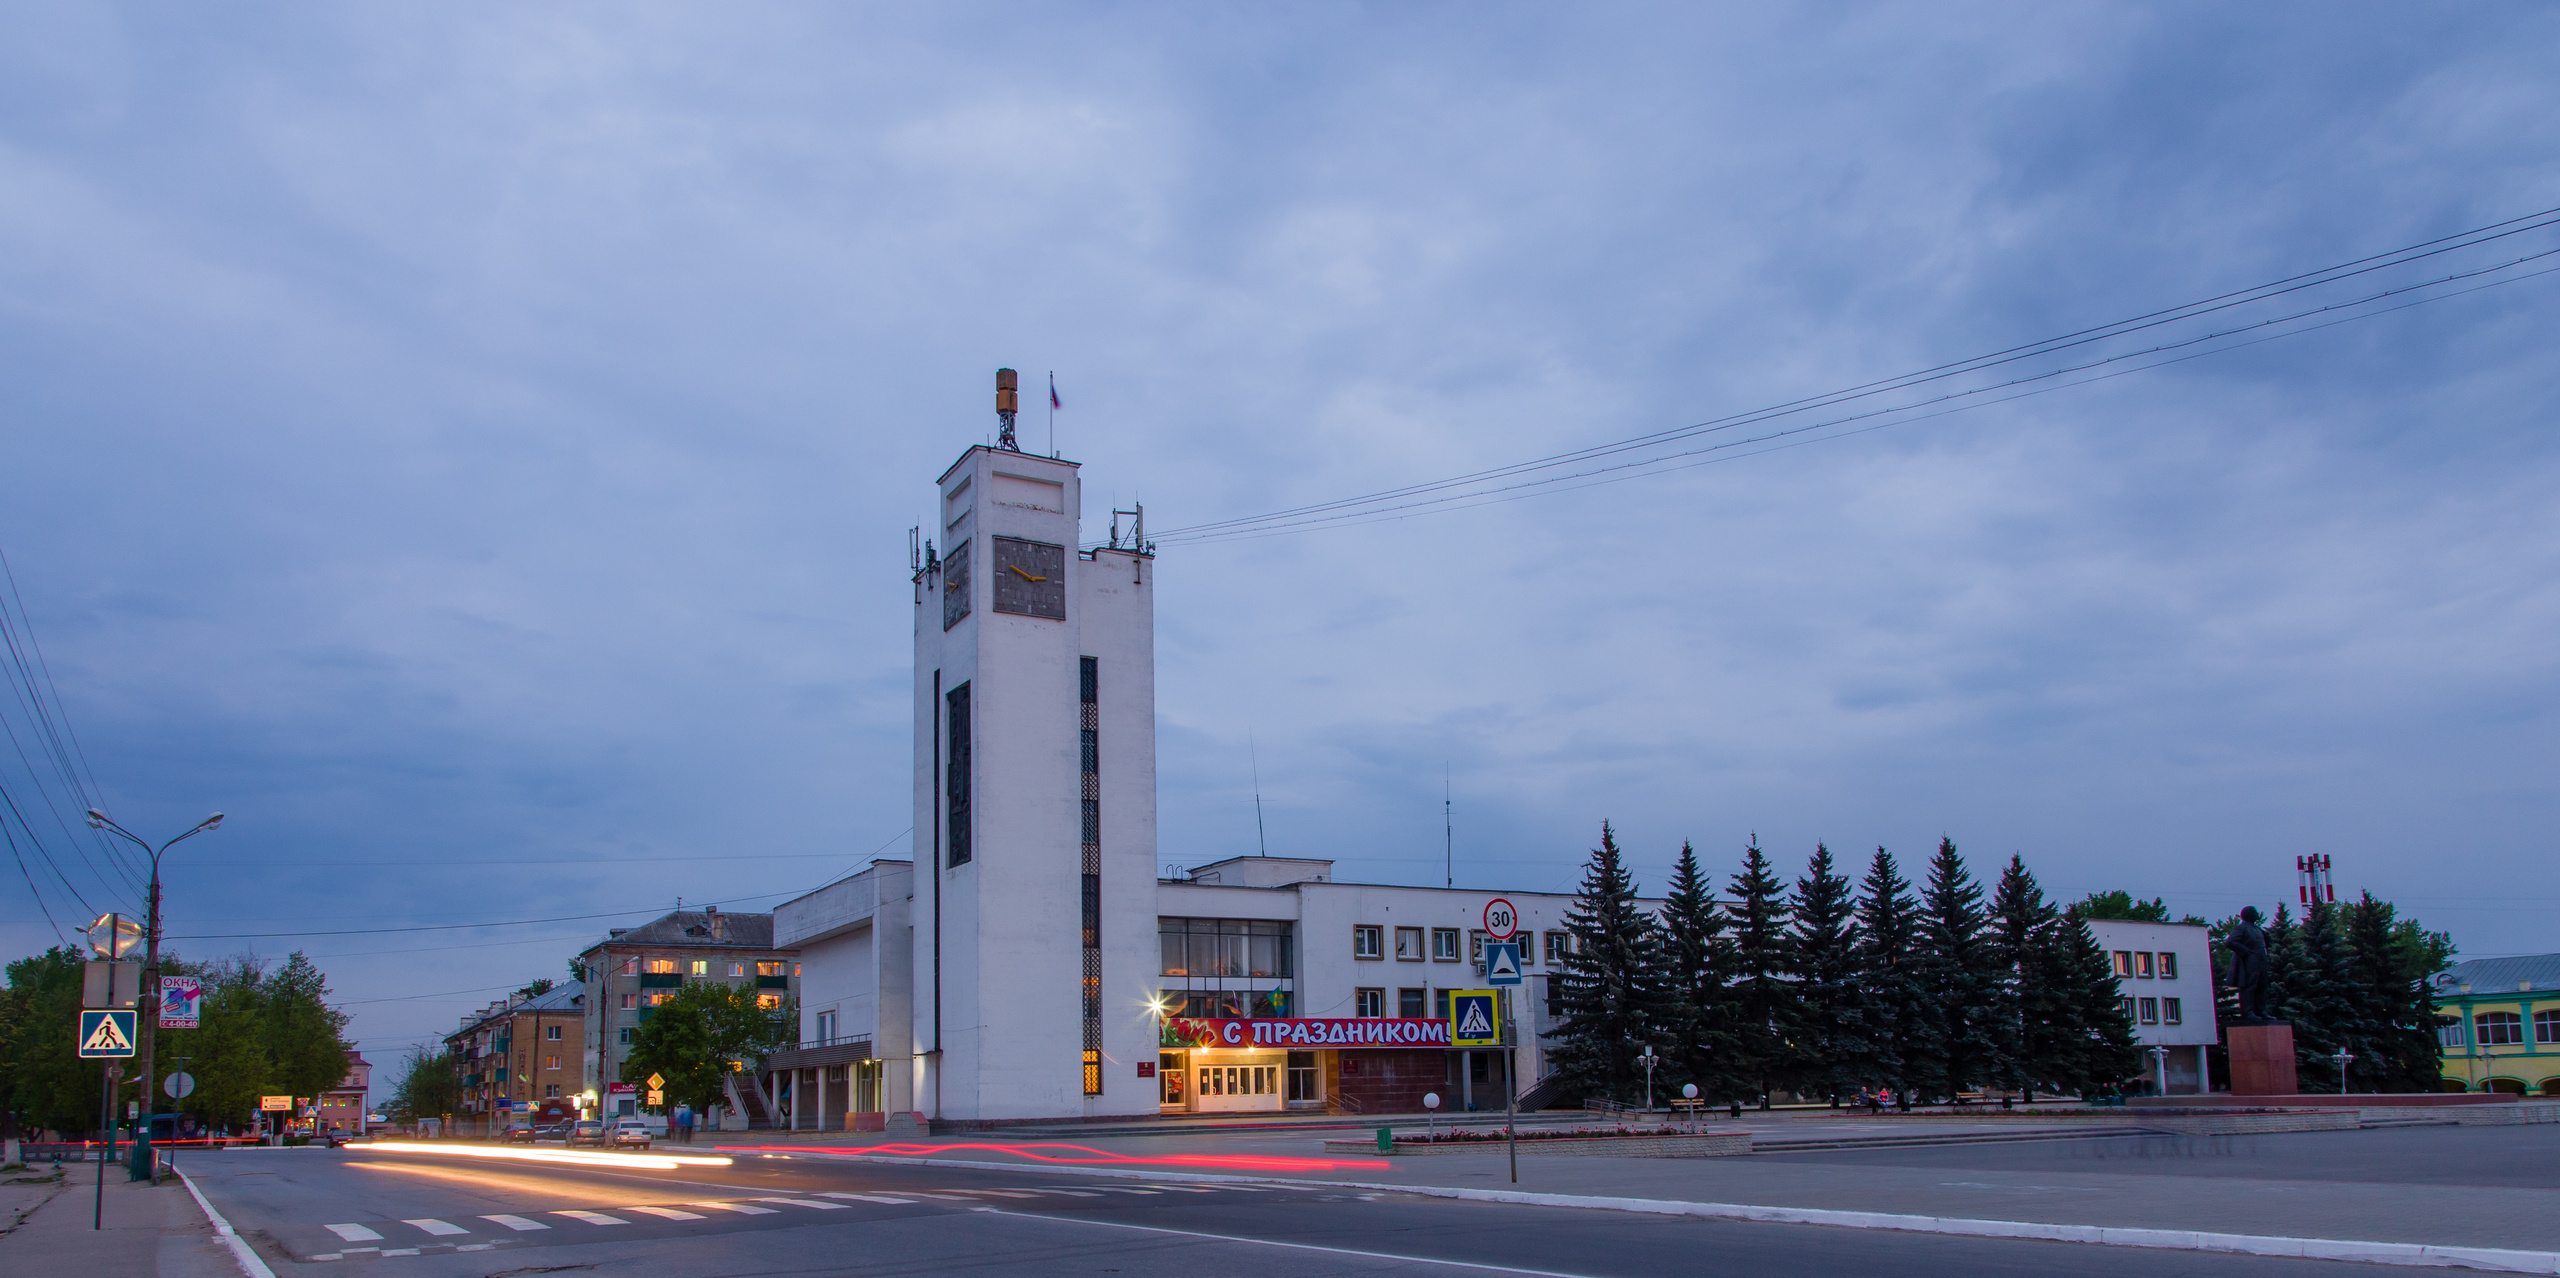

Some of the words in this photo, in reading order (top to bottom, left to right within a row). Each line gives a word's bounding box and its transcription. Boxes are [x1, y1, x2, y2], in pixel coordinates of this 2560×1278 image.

[1491, 911, 1510, 927] 30
[163, 978, 199, 987] ОКНА
[1223, 1021, 1242, 1044] С
[1251, 1021, 1452, 1044] ПРАЗДНИКОМ!
